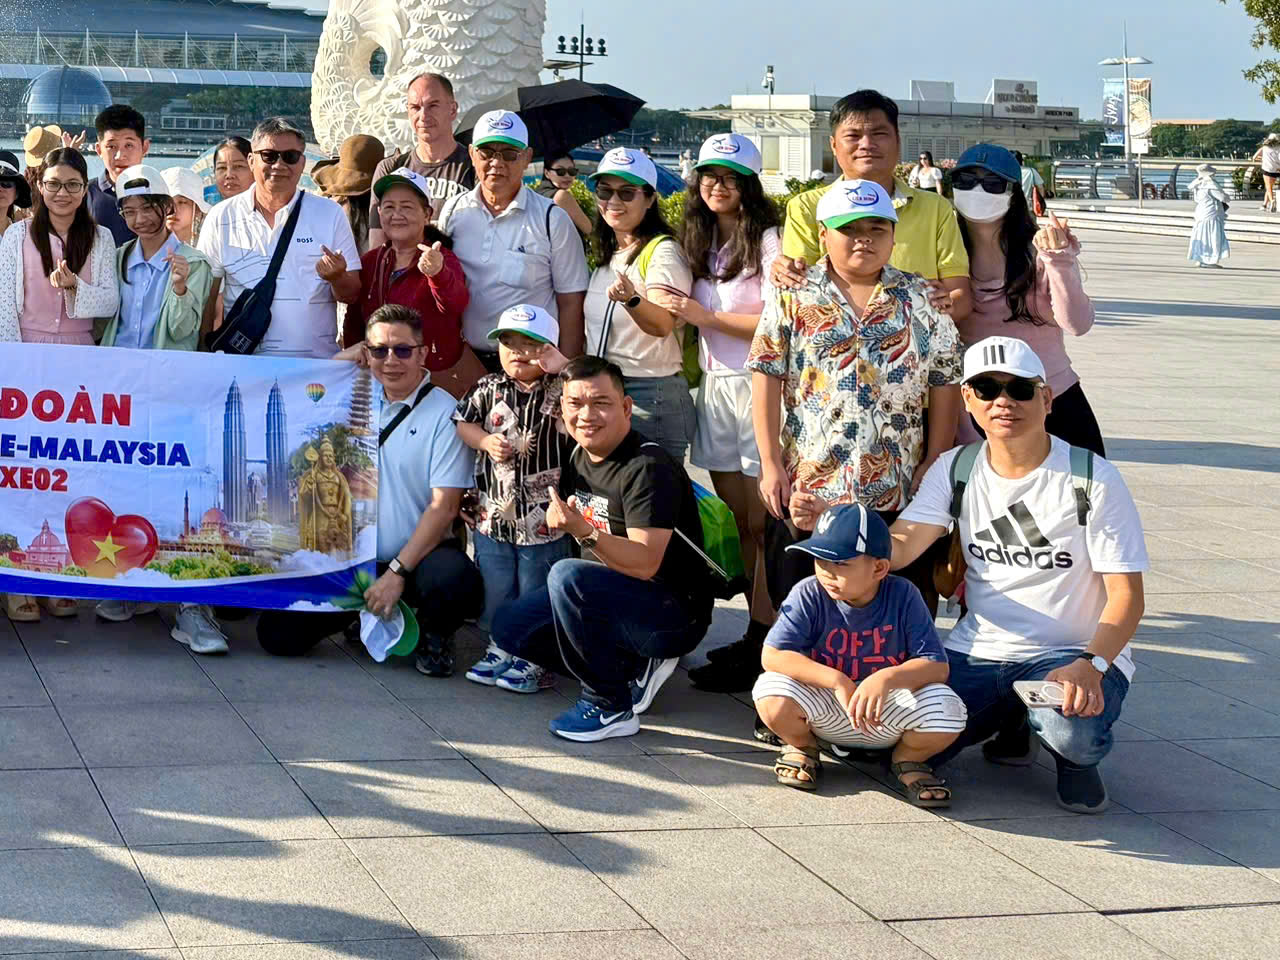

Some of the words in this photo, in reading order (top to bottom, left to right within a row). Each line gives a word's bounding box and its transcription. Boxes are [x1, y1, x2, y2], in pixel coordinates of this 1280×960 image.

[0, 385, 132, 426] ĐOÀN
[0, 465, 68, 492] XE02
[968, 543, 1073, 570] adidas
[825, 625, 893, 657] OFF
